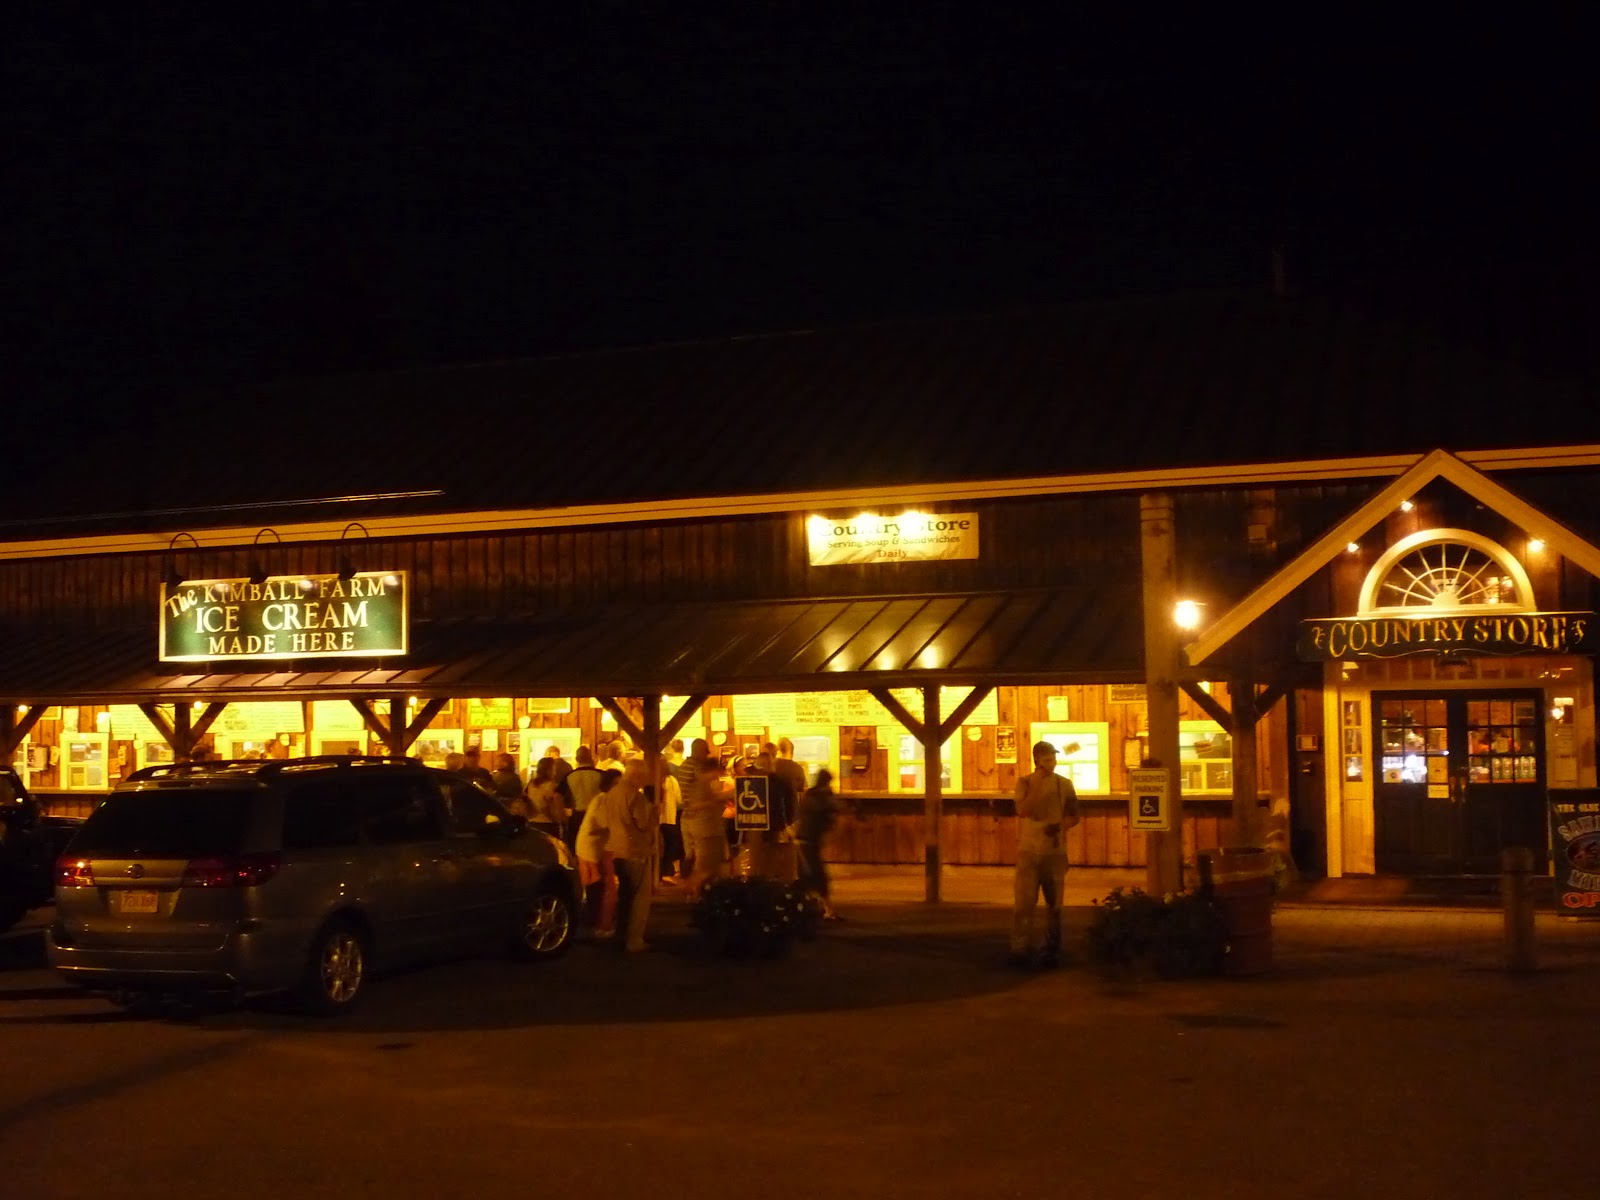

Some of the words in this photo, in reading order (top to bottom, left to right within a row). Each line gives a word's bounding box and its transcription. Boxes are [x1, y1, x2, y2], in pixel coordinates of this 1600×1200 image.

[819, 521, 902, 537] Coutry
[915, 519, 971, 532] tore
[865, 538, 889, 547] Soup
[903, 535, 960, 545] Sandwiches
[877, 549, 909, 559] Daily
[165, 589, 198, 618] The
[203, 580, 305, 603] KIMBALL
[318, 578, 387, 599] FARM
[194, 605, 240, 634] ICE
[261, 600, 369, 631] CREAM
[208, 634, 276, 655] MADE
[291, 631, 355, 652] HERE
[1328, 617, 1469, 658] COUNTRY
[1473, 616, 1569, 653] STORE
[737, 813, 767, 824] PARKING
